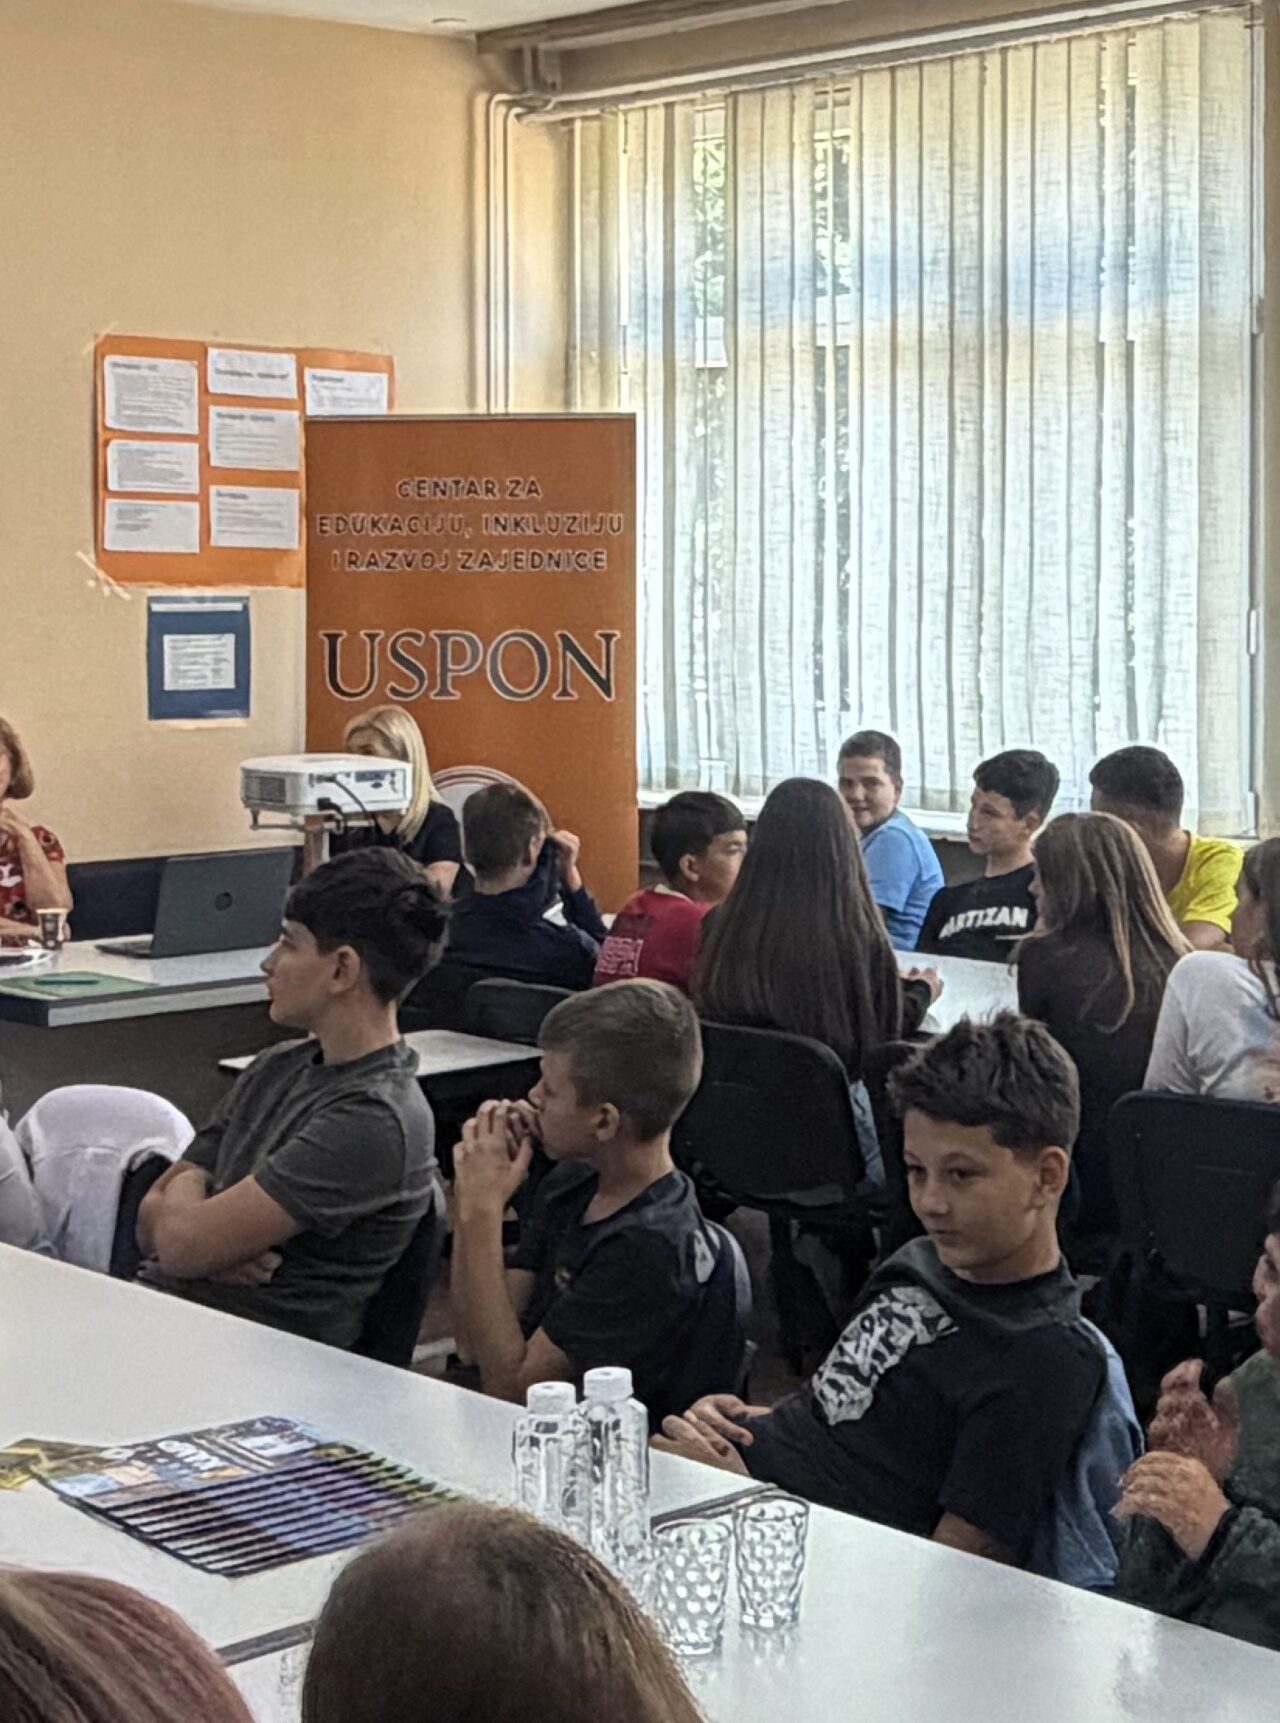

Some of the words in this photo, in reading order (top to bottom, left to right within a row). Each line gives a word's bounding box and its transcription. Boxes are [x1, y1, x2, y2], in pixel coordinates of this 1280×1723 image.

[397, 477, 499, 499] CENTAR
[506, 477, 543, 499] ZA
[316, 513, 473, 539] EDUKACIJU,
[482, 512, 624, 535] INKLUZIJU
[331, 551, 341, 570] I
[346, 551, 450, 571] RAZVOJ
[457, 550, 608, 571] ZAJEDNICE
[319, 628, 621, 701] USPON
